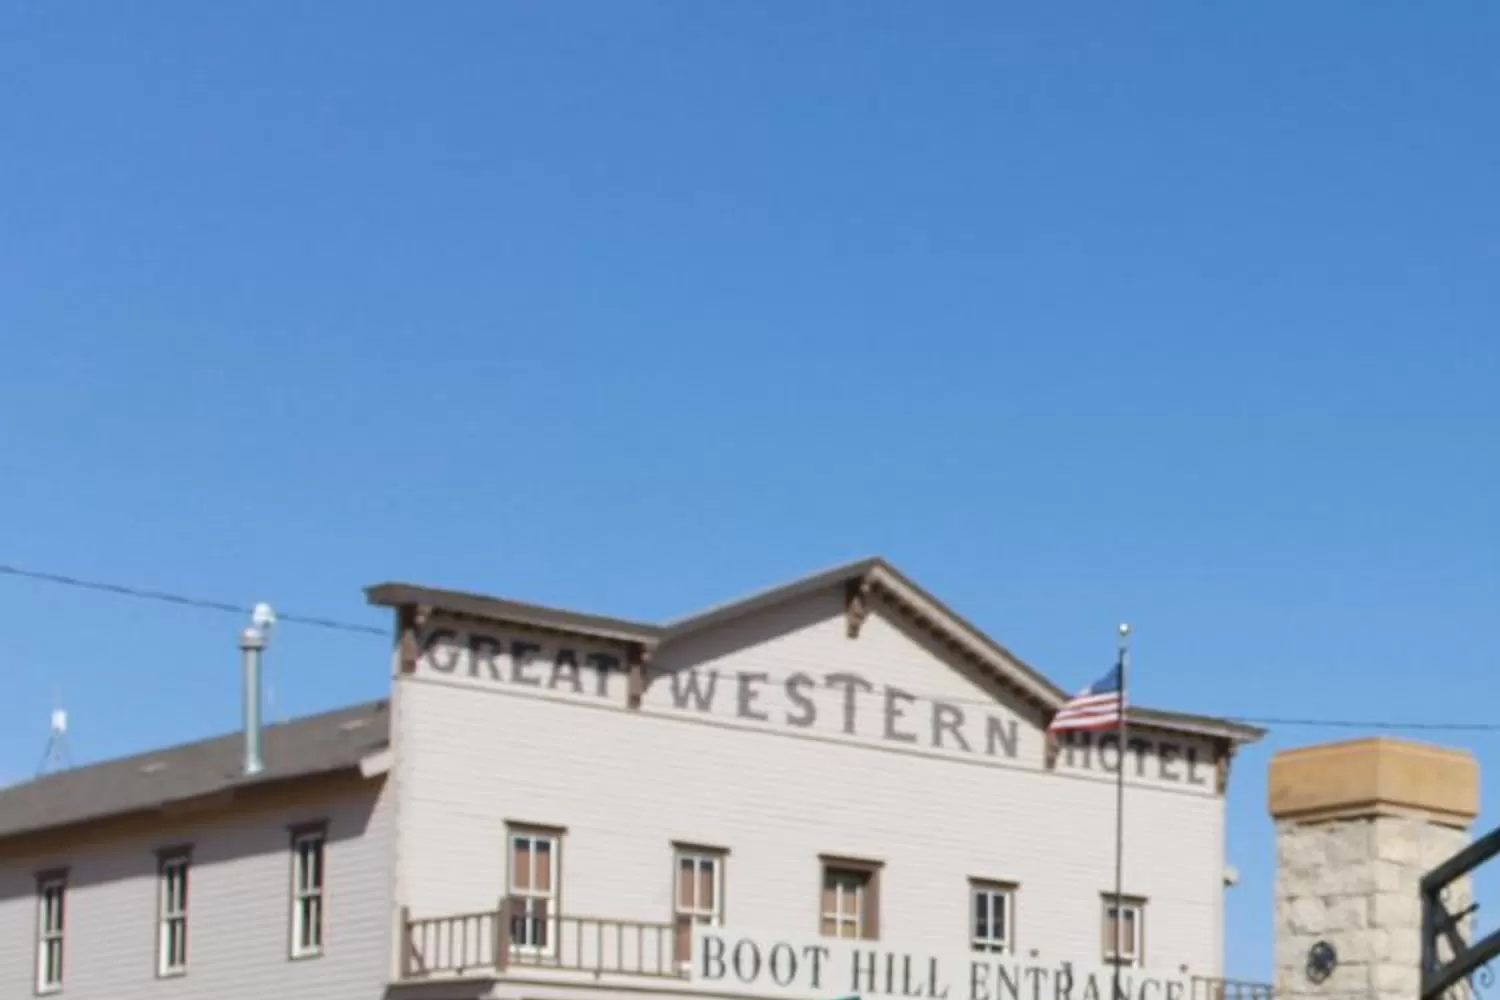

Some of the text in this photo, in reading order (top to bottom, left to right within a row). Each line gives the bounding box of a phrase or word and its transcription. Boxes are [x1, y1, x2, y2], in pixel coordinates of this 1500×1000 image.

[422, 626, 1207, 784] GREAT WESTERN HOTEL
[701, 935, 829, 990] BOOT
[851, 950, 950, 1000] HILL
